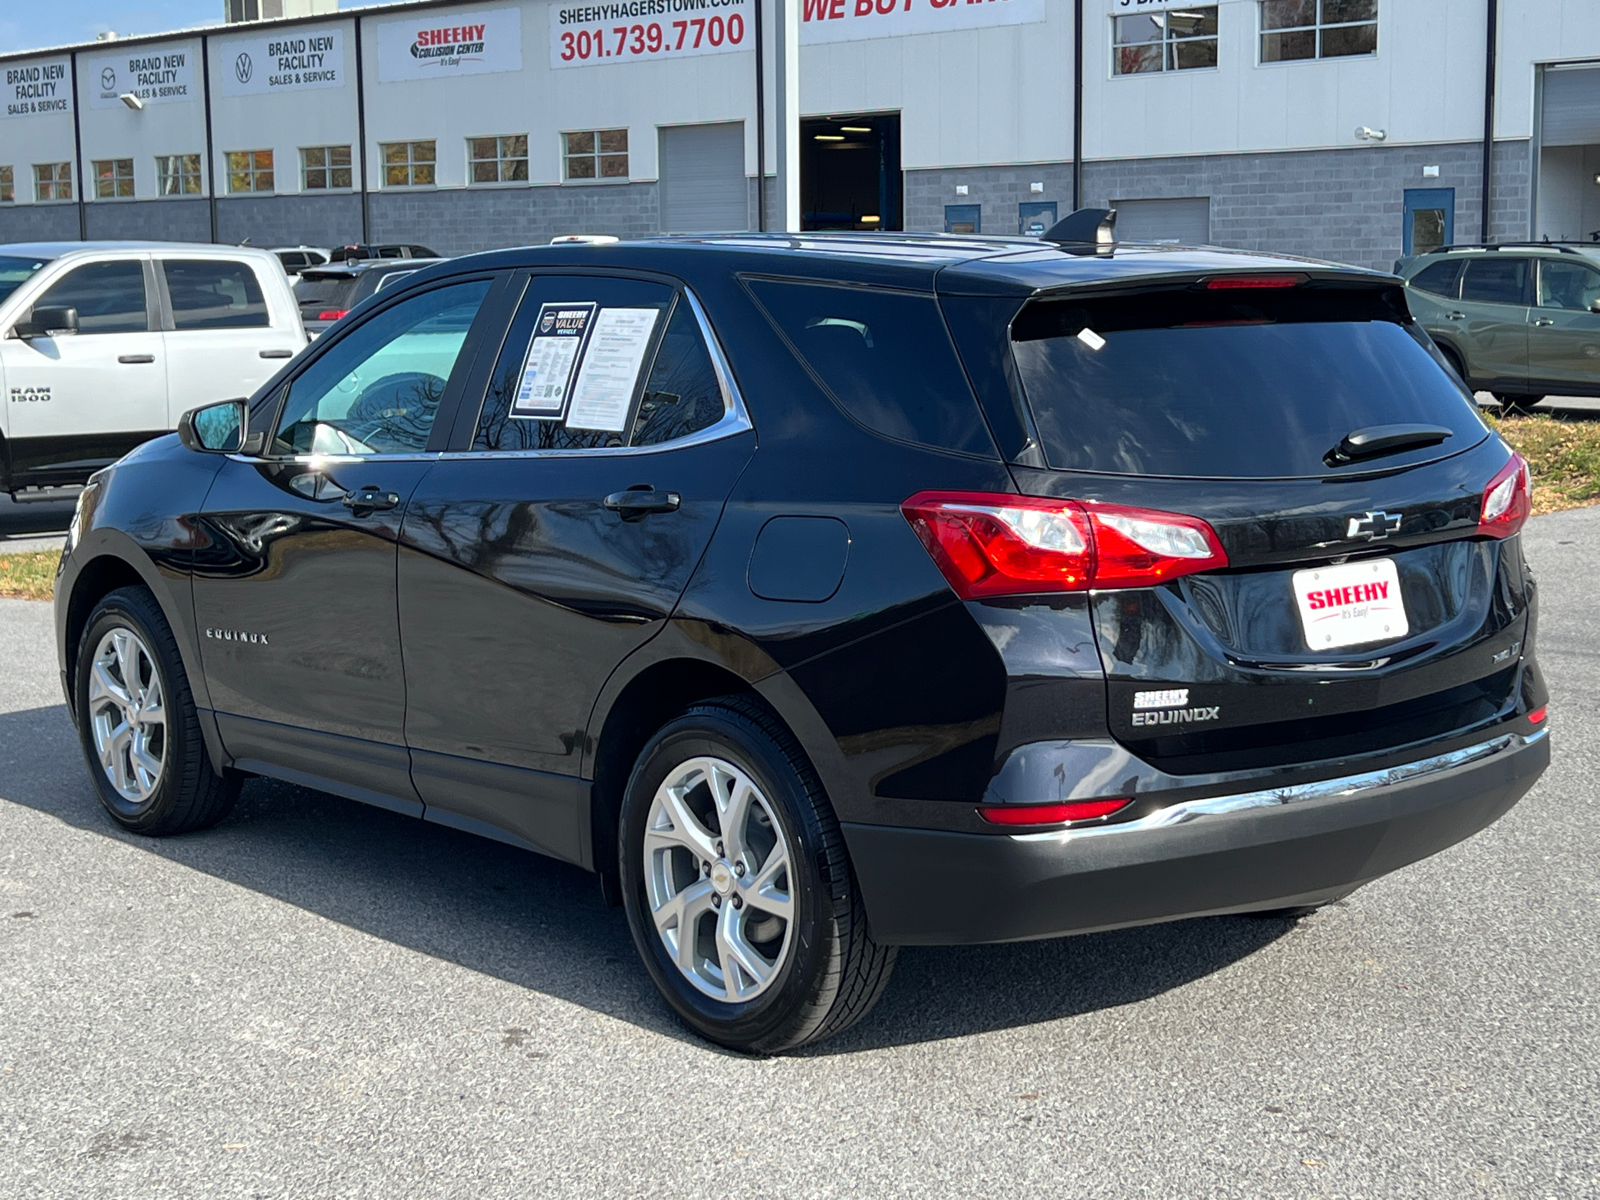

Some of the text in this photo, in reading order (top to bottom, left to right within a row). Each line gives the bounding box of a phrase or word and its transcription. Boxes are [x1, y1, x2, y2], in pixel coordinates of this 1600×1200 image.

[417, 24, 486, 47] SHEEHY
[560, 13, 744, 61] 301.739.7700
[268, 36, 334, 57] BRAND NEW
[418, 42, 485, 59] COLLISION CENTER
[129, 54, 185, 73] BRAND NEW
[278, 53, 324, 71] FACILITY
[7, 64, 65, 85] BRAND NEW
[137, 69, 177, 86] FACILITY
[268, 70, 336, 87] SALES & SERVICE
[15, 82, 56, 100] FACILITY
[151, 88, 157, 98] &
[159, 85, 187, 97] SERVICE
[7, 99, 67, 115] SALES & SERVICE
[555, 318, 586, 329] VALUE
[1306, 580, 1389, 610] SHEEHY
[1341, 608, 1352, 620] It's
[205, 628, 269, 645] EQUINOX
[1134, 689, 1189, 701] SHEEHY
[1132, 706, 1220, 726] EQUINOX
